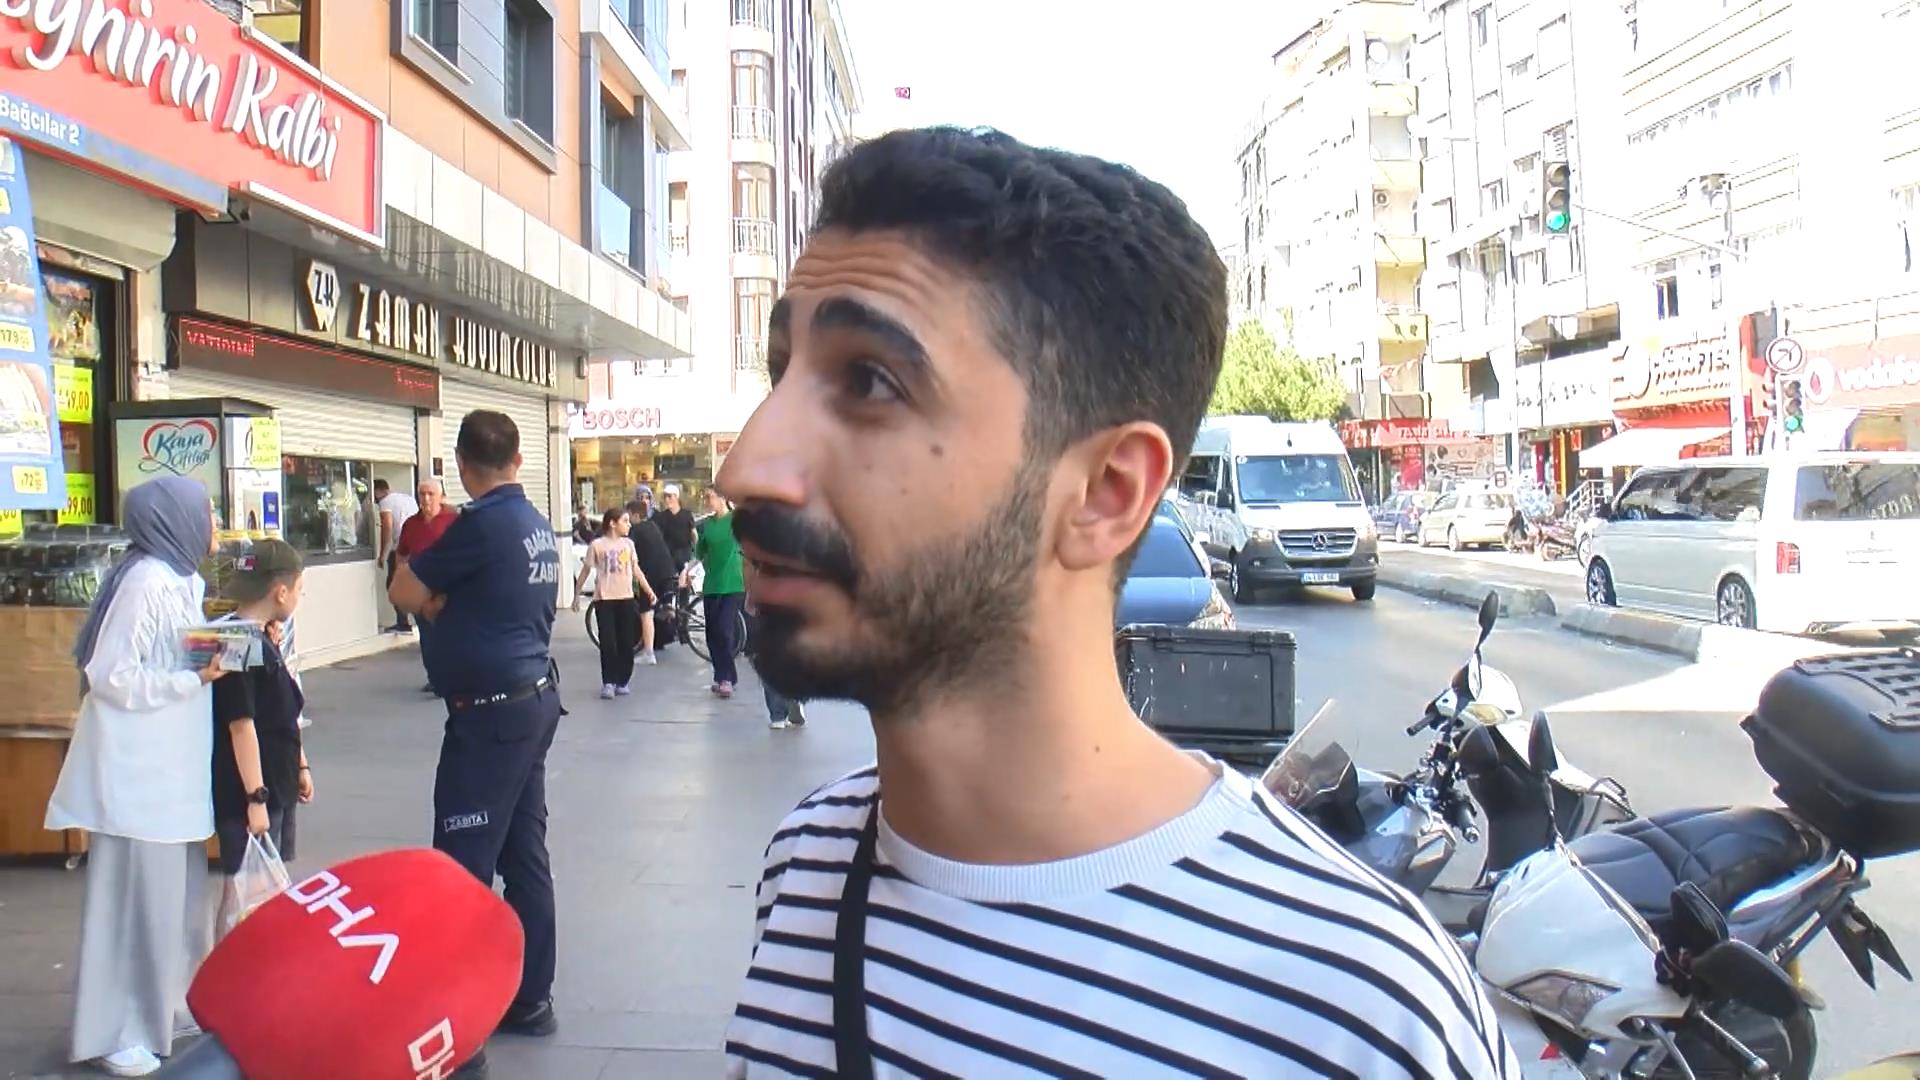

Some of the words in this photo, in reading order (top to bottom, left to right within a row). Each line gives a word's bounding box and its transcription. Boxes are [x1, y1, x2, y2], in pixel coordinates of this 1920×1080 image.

[0, 95, 67, 140] Bağcılar
[69, 123, 80, 146] 2
[232, 53, 343, 182] Kalbi
[357, 282, 439, 359] ZAMAN
[452, 316, 557, 390] KUYUMCULUK
[582, 407, 661, 430] BOSCH
[154, 430, 205, 464] Kaya
[474, 692, 508, 706] ZAITA
[448, 814, 483, 830] ZABITA
[286, 869, 400, 985] DHA
